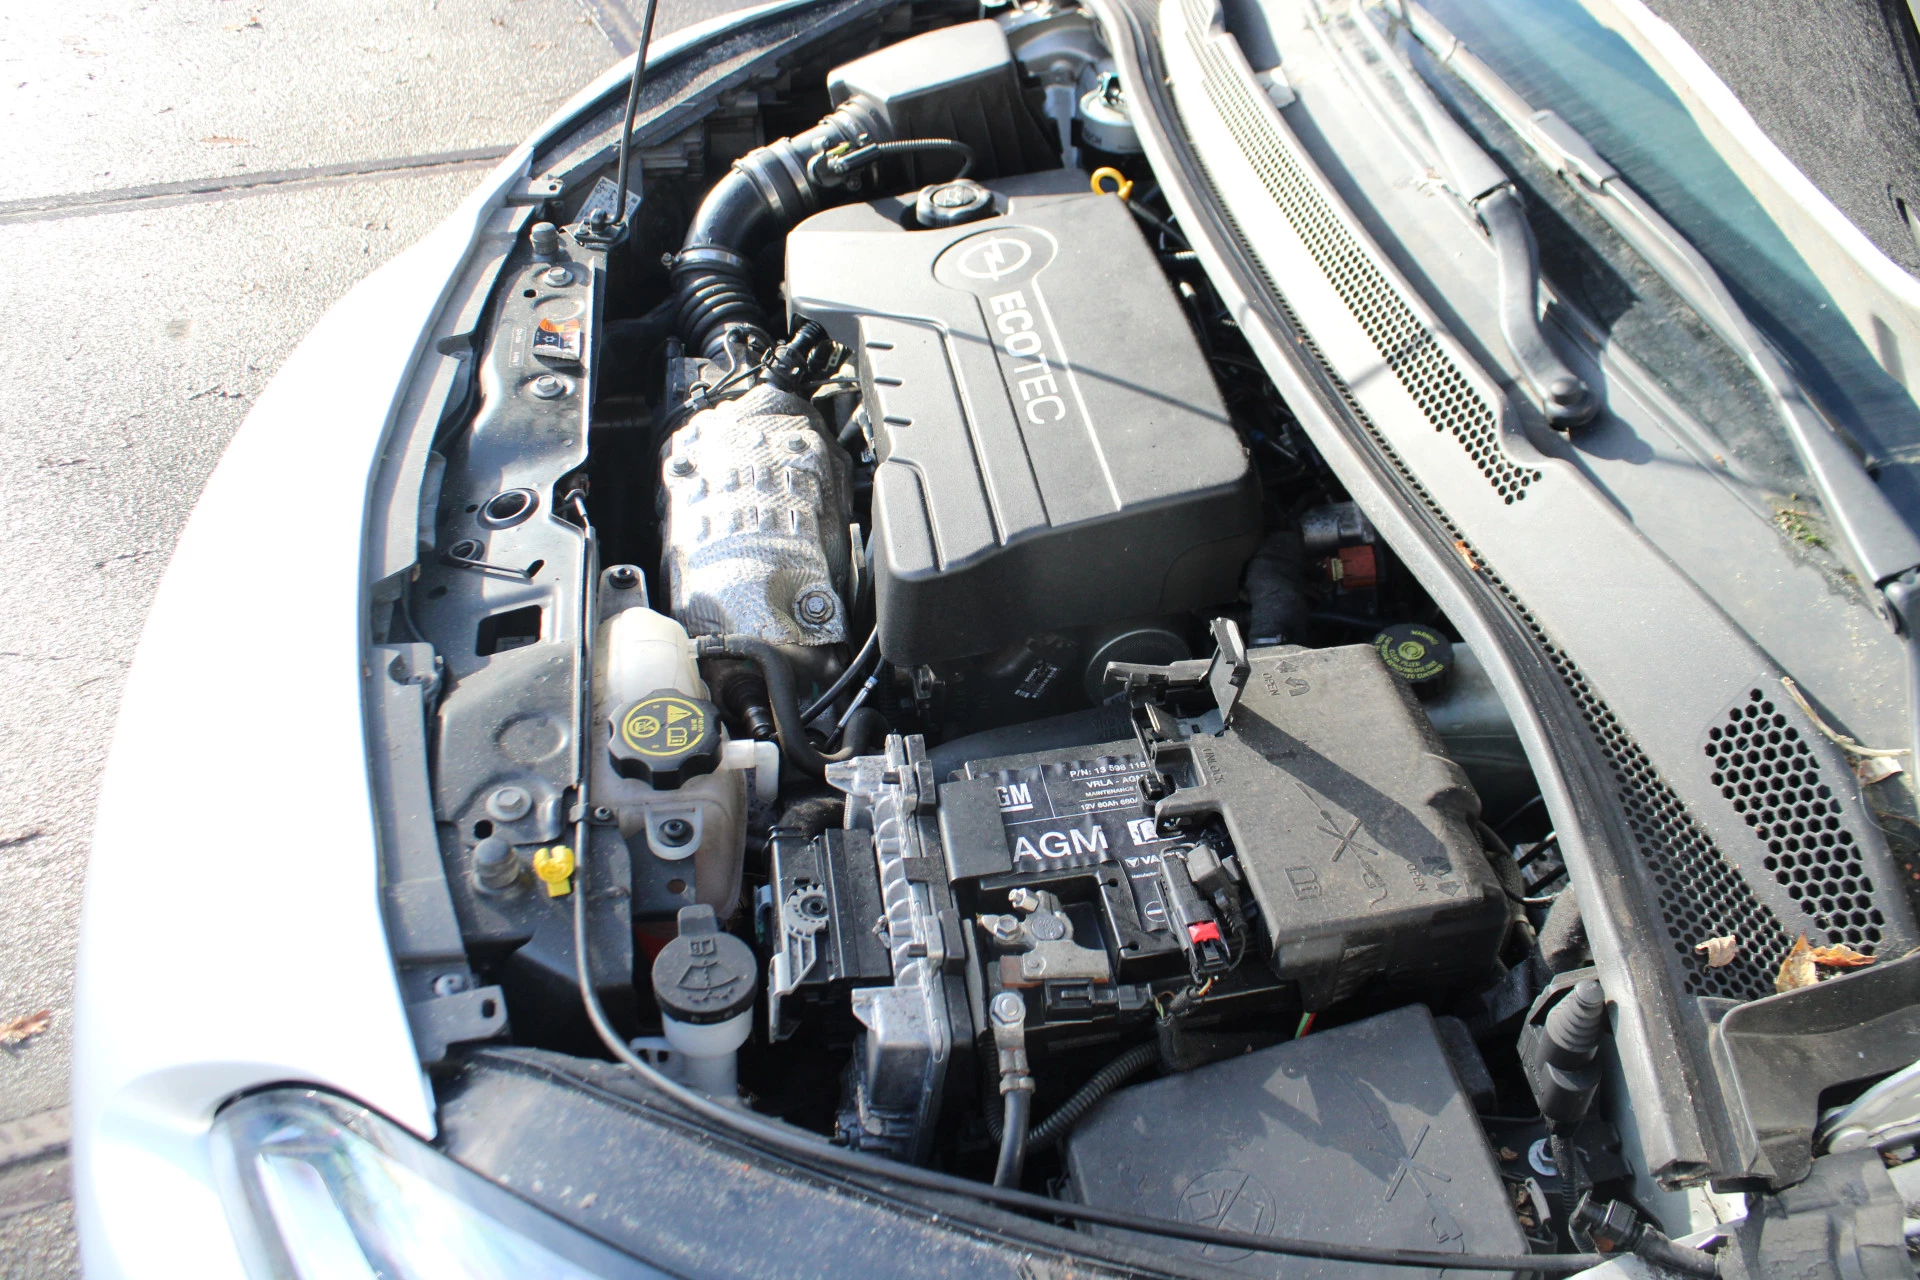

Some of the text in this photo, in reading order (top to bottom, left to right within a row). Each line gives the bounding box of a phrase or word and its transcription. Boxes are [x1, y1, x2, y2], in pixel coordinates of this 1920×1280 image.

[989, 291, 1066, 424] ECOTEC
[1410, 629, 1439, 646] WARNING
[1262, 672, 1280, 696] OPEN
[1069, 769, 1092, 778] P/N:
[1094, 766, 1106, 775] 13
[1202, 748, 1225, 785] UNLOCK
[995, 783, 1031, 807] GM
[1085, 785, 1134, 797] MAINTENANCE
[1086, 779, 1114, 788] VRLA
[1081, 802, 1095, 811] 12V
[1097, 799, 1119, 808] 60Ah
[1013, 825, 1108, 863] AGM
[1406, 863, 1428, 891] OPEN
